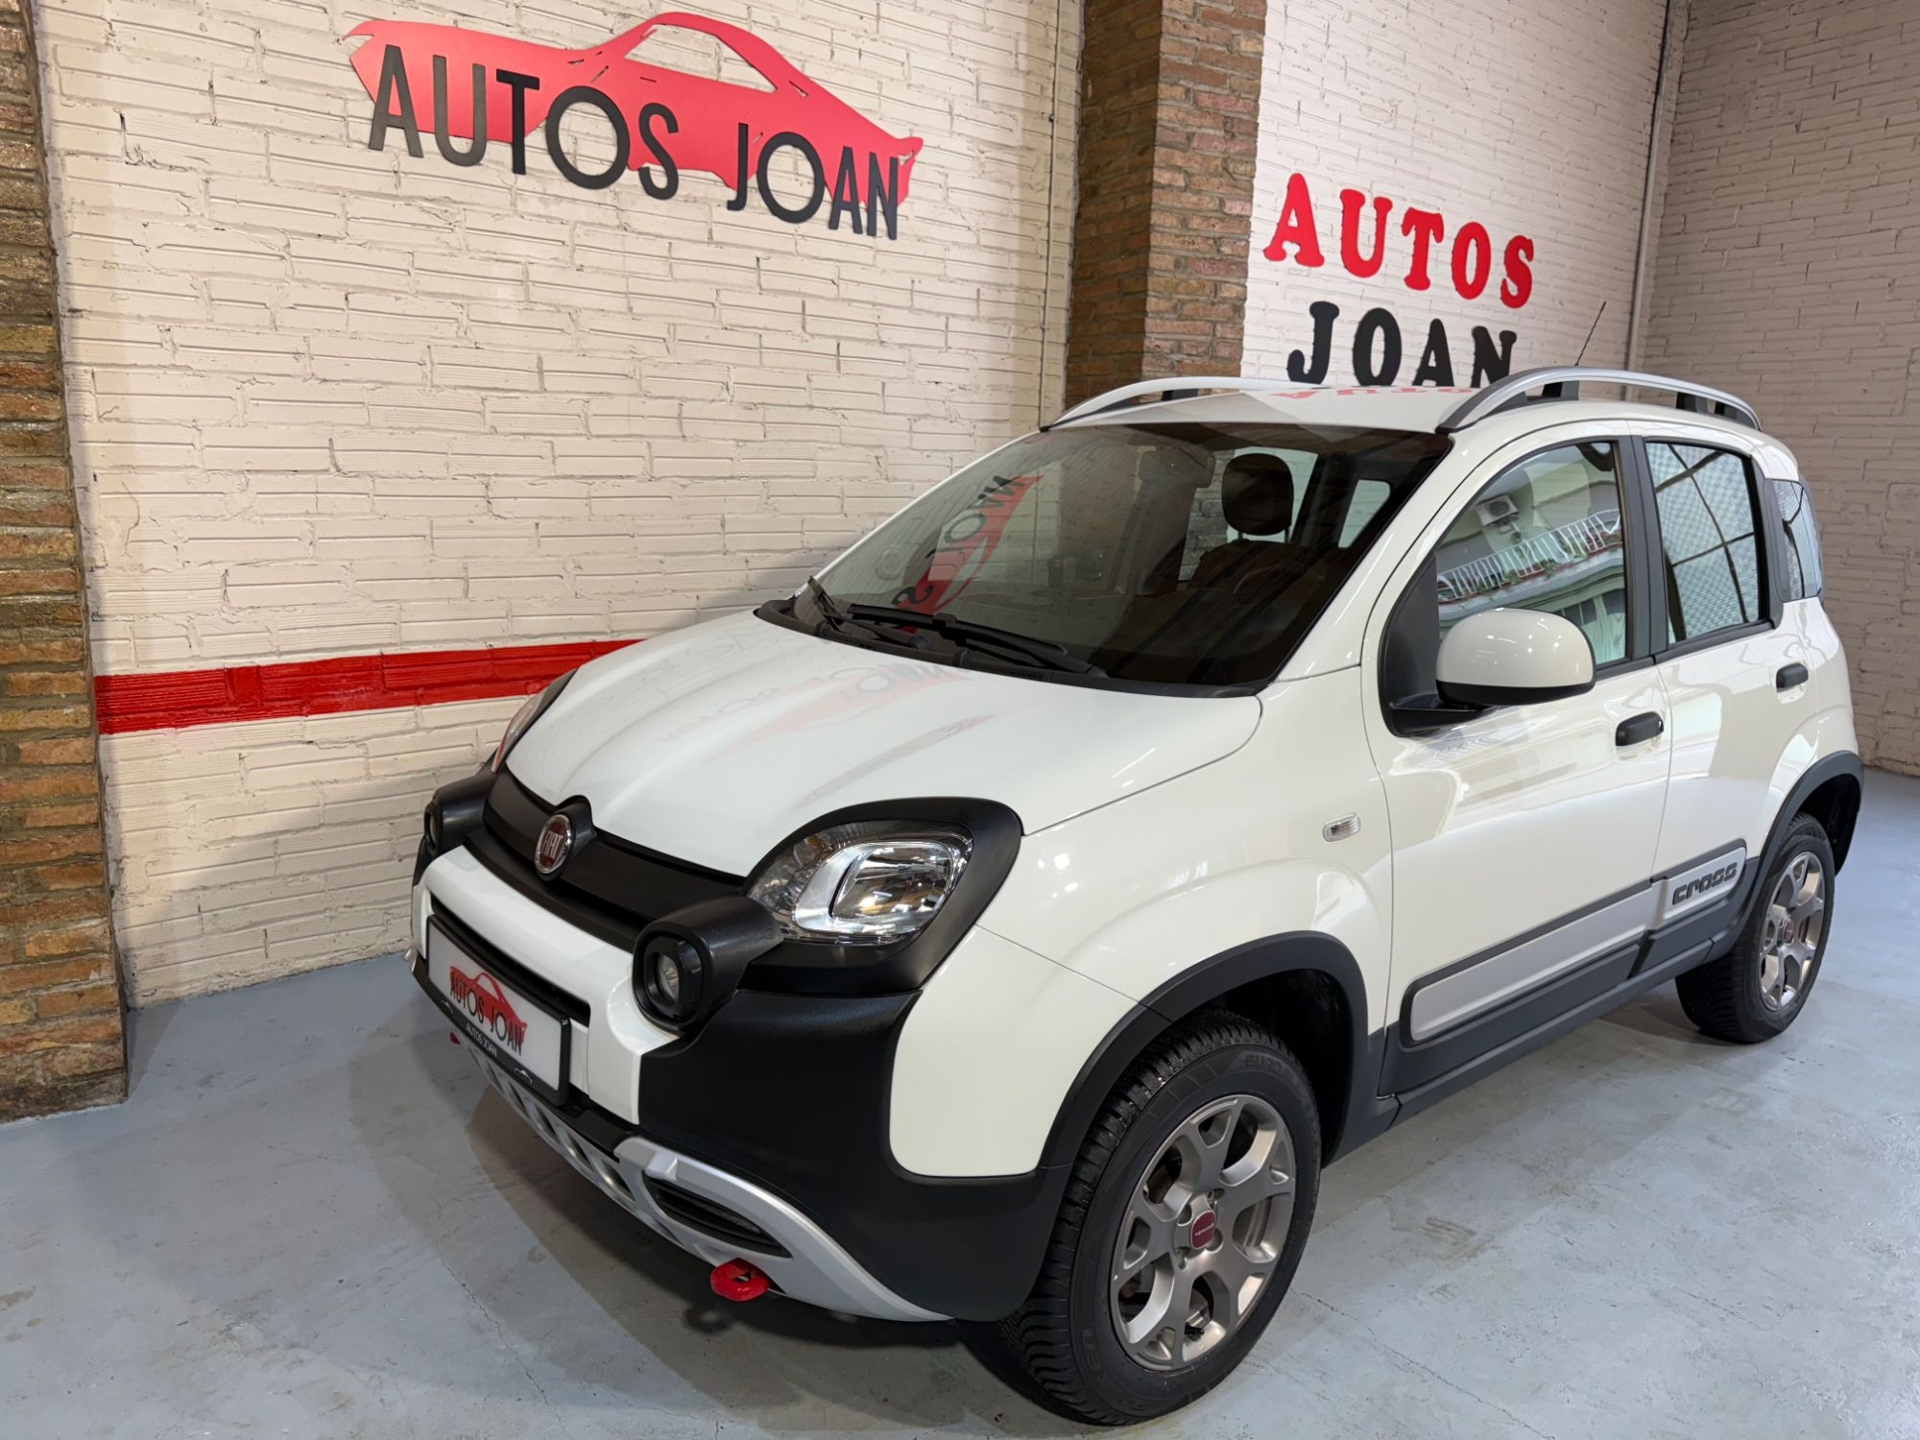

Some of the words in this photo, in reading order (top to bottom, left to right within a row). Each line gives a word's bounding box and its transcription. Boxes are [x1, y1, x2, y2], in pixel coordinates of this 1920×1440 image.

[368, 44, 680, 201] AUTOS
[726, 122, 898, 241] JOAN
[1263, 172, 1535, 309] AUTOS
[1286, 300, 1518, 388] JOAN
[540, 830, 565, 860] FIAT
[450, 971, 485, 1024] AUTOS
[490, 1006, 524, 1057] JOAN
